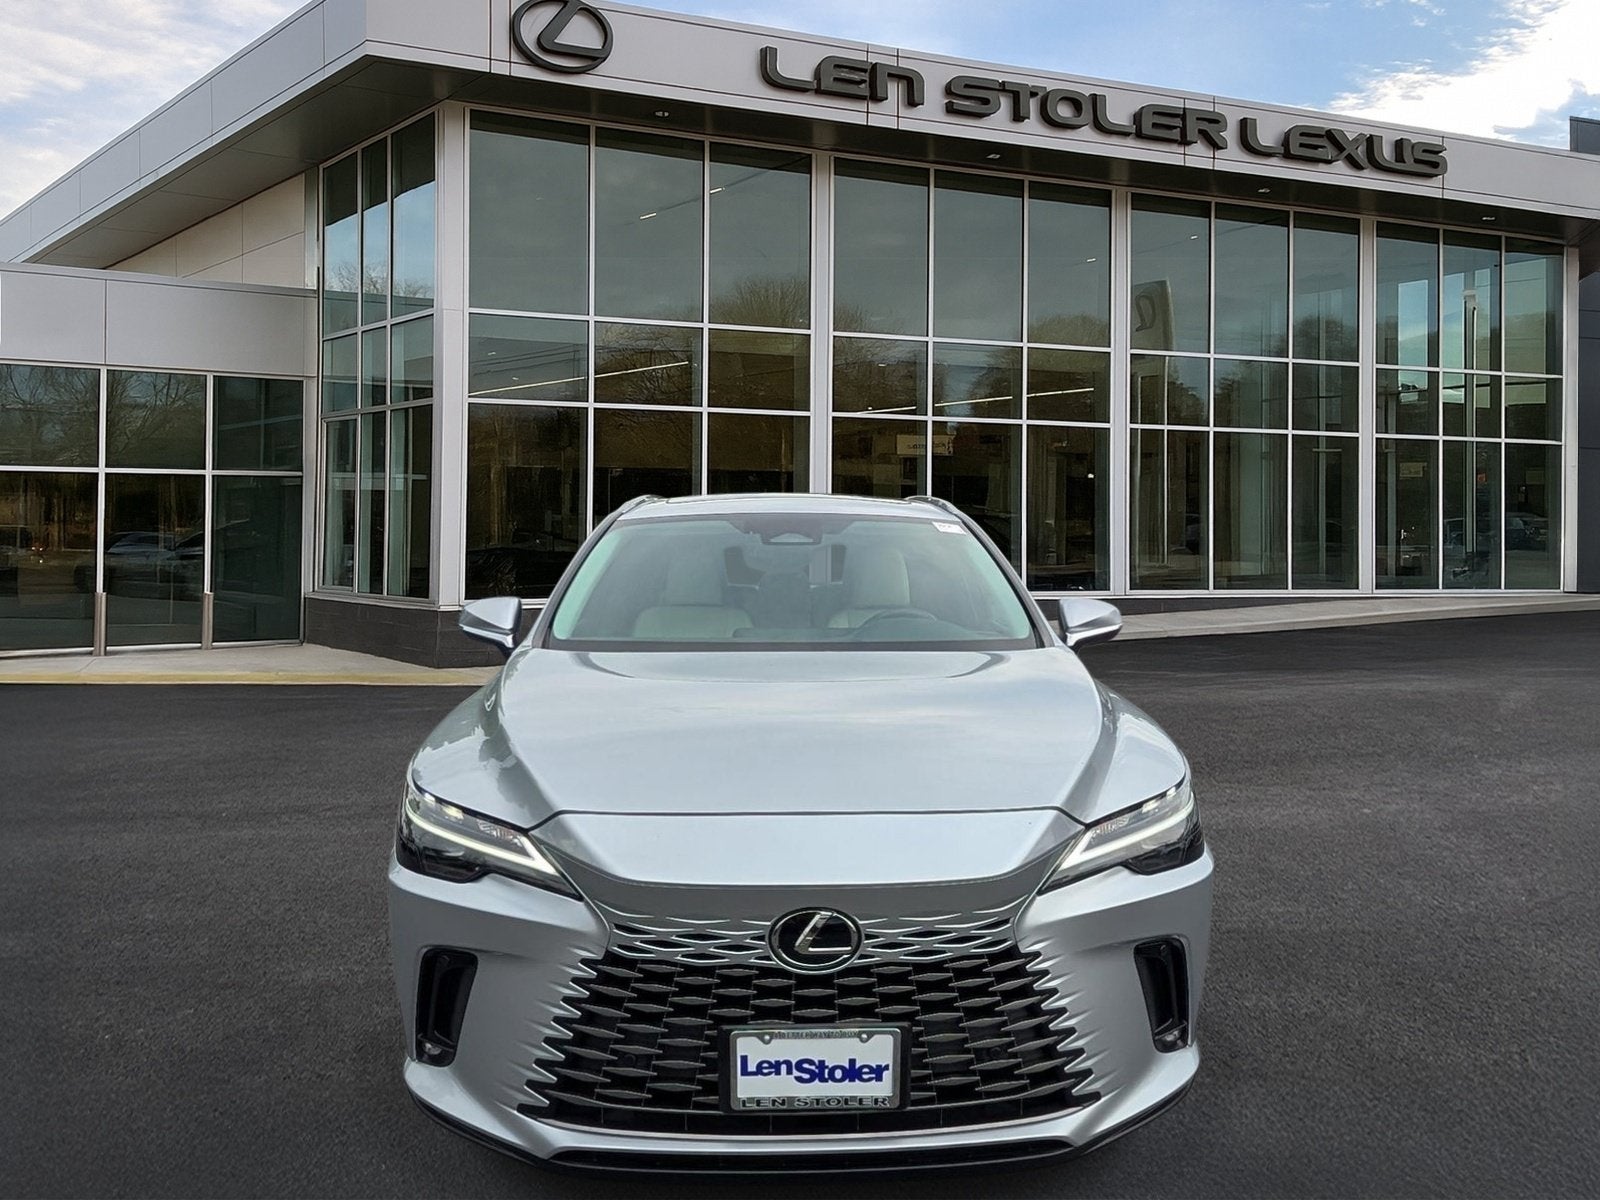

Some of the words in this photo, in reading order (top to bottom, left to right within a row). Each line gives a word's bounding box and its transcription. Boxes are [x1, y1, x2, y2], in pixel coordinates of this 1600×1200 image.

[945, 75, 1227, 149] STOLER
[1240, 117, 1448, 177] LEXUS
[741, 1097, 787, 1109] LEN
[794, 1096, 891, 1108] STOLER
